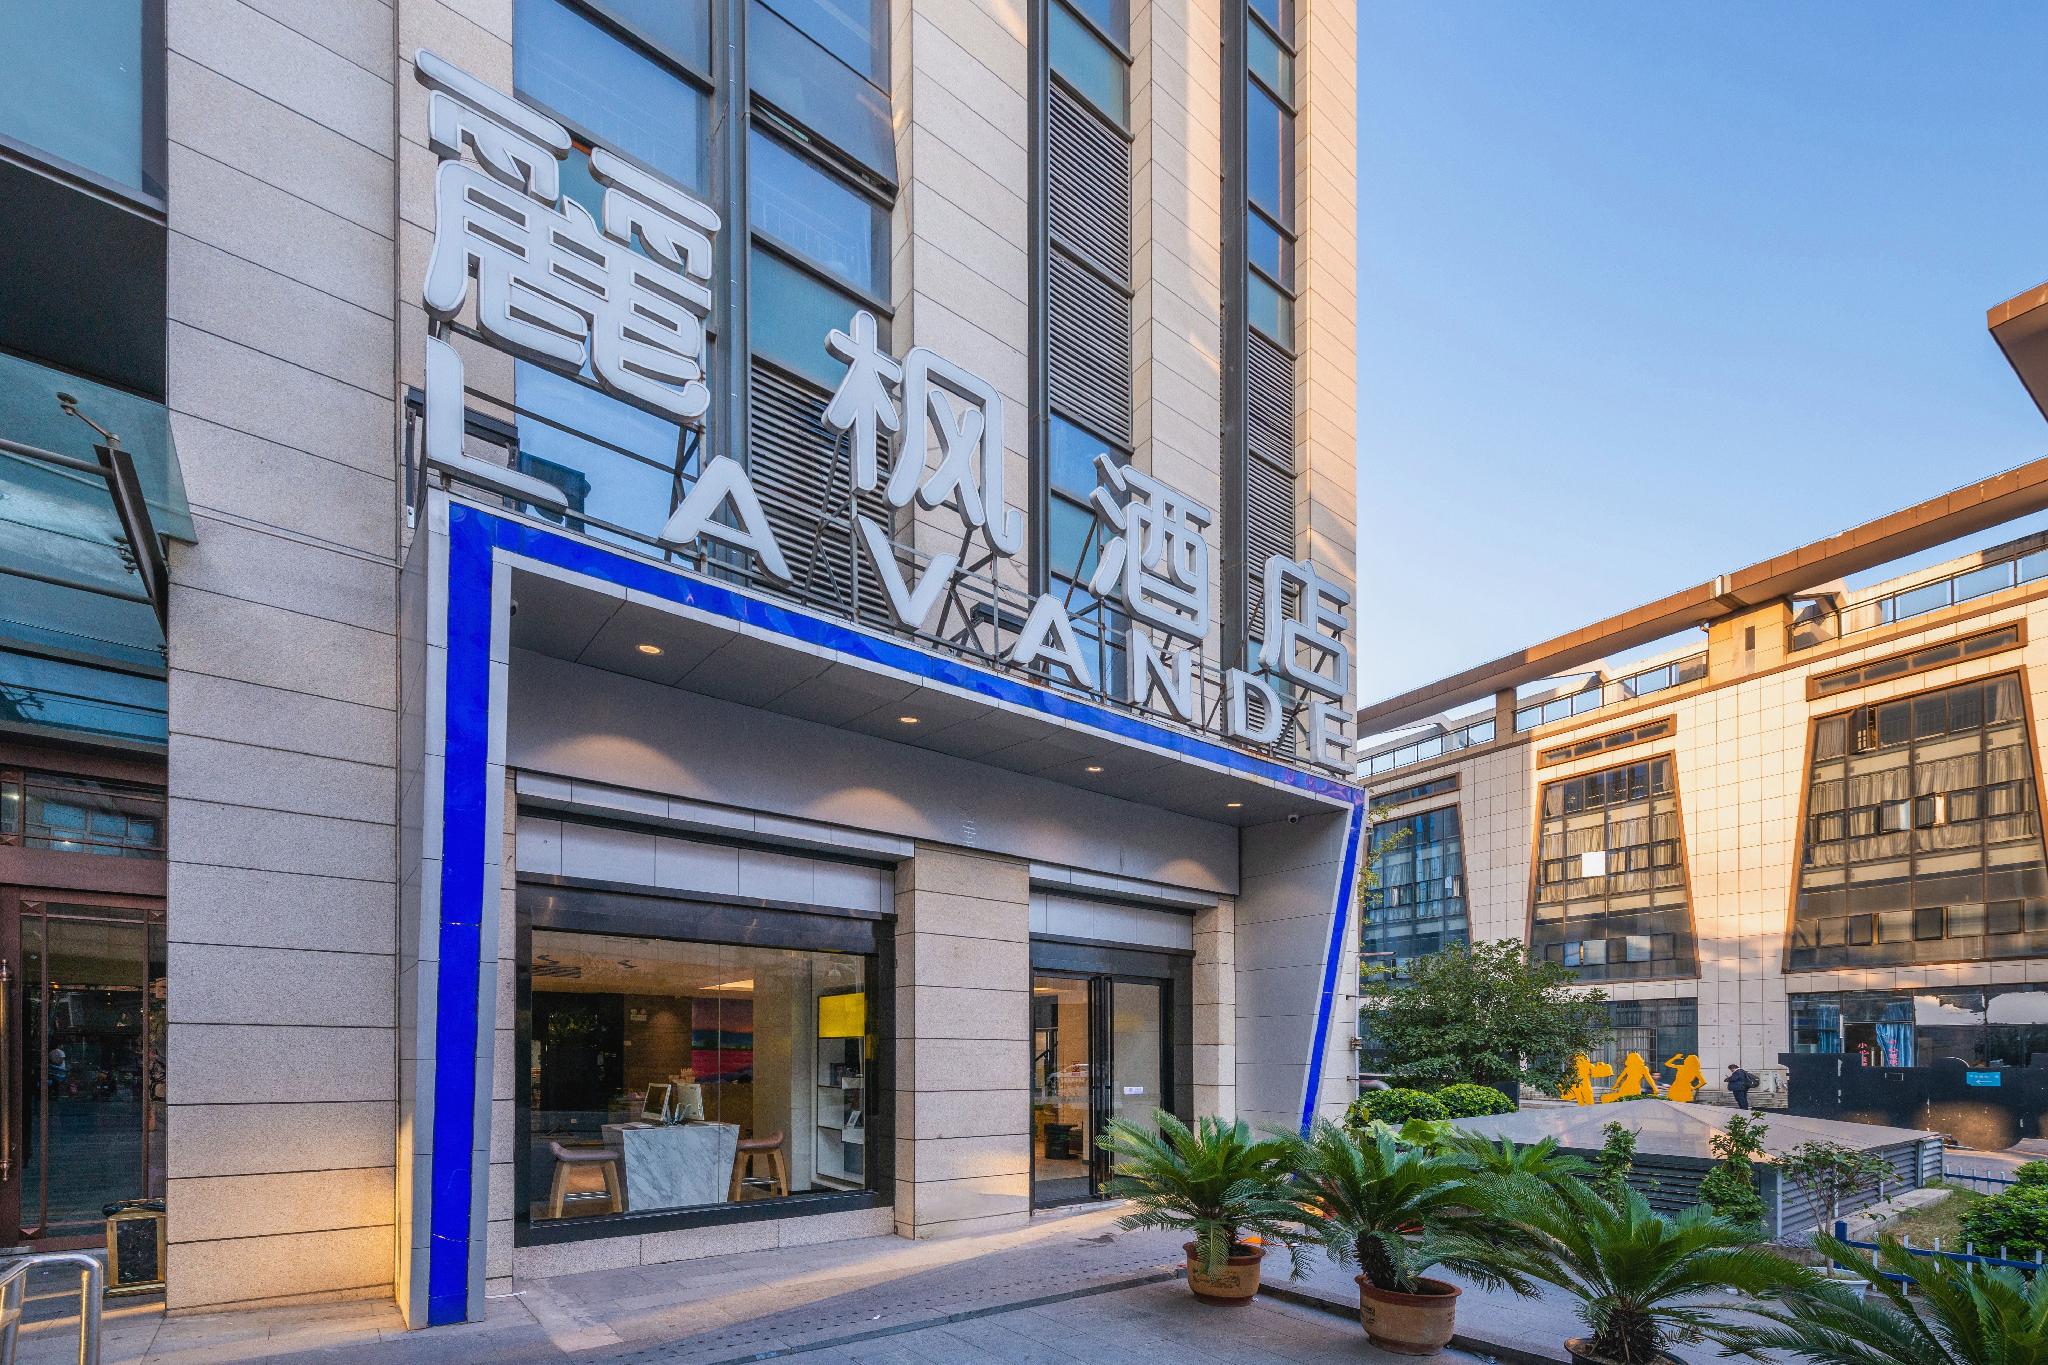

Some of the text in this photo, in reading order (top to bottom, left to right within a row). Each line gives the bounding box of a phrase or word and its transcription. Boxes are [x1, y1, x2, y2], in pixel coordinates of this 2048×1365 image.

[414, 48, 1351, 700] 麗枫酒店
[424, 335, 1354, 774] LAVANDE
